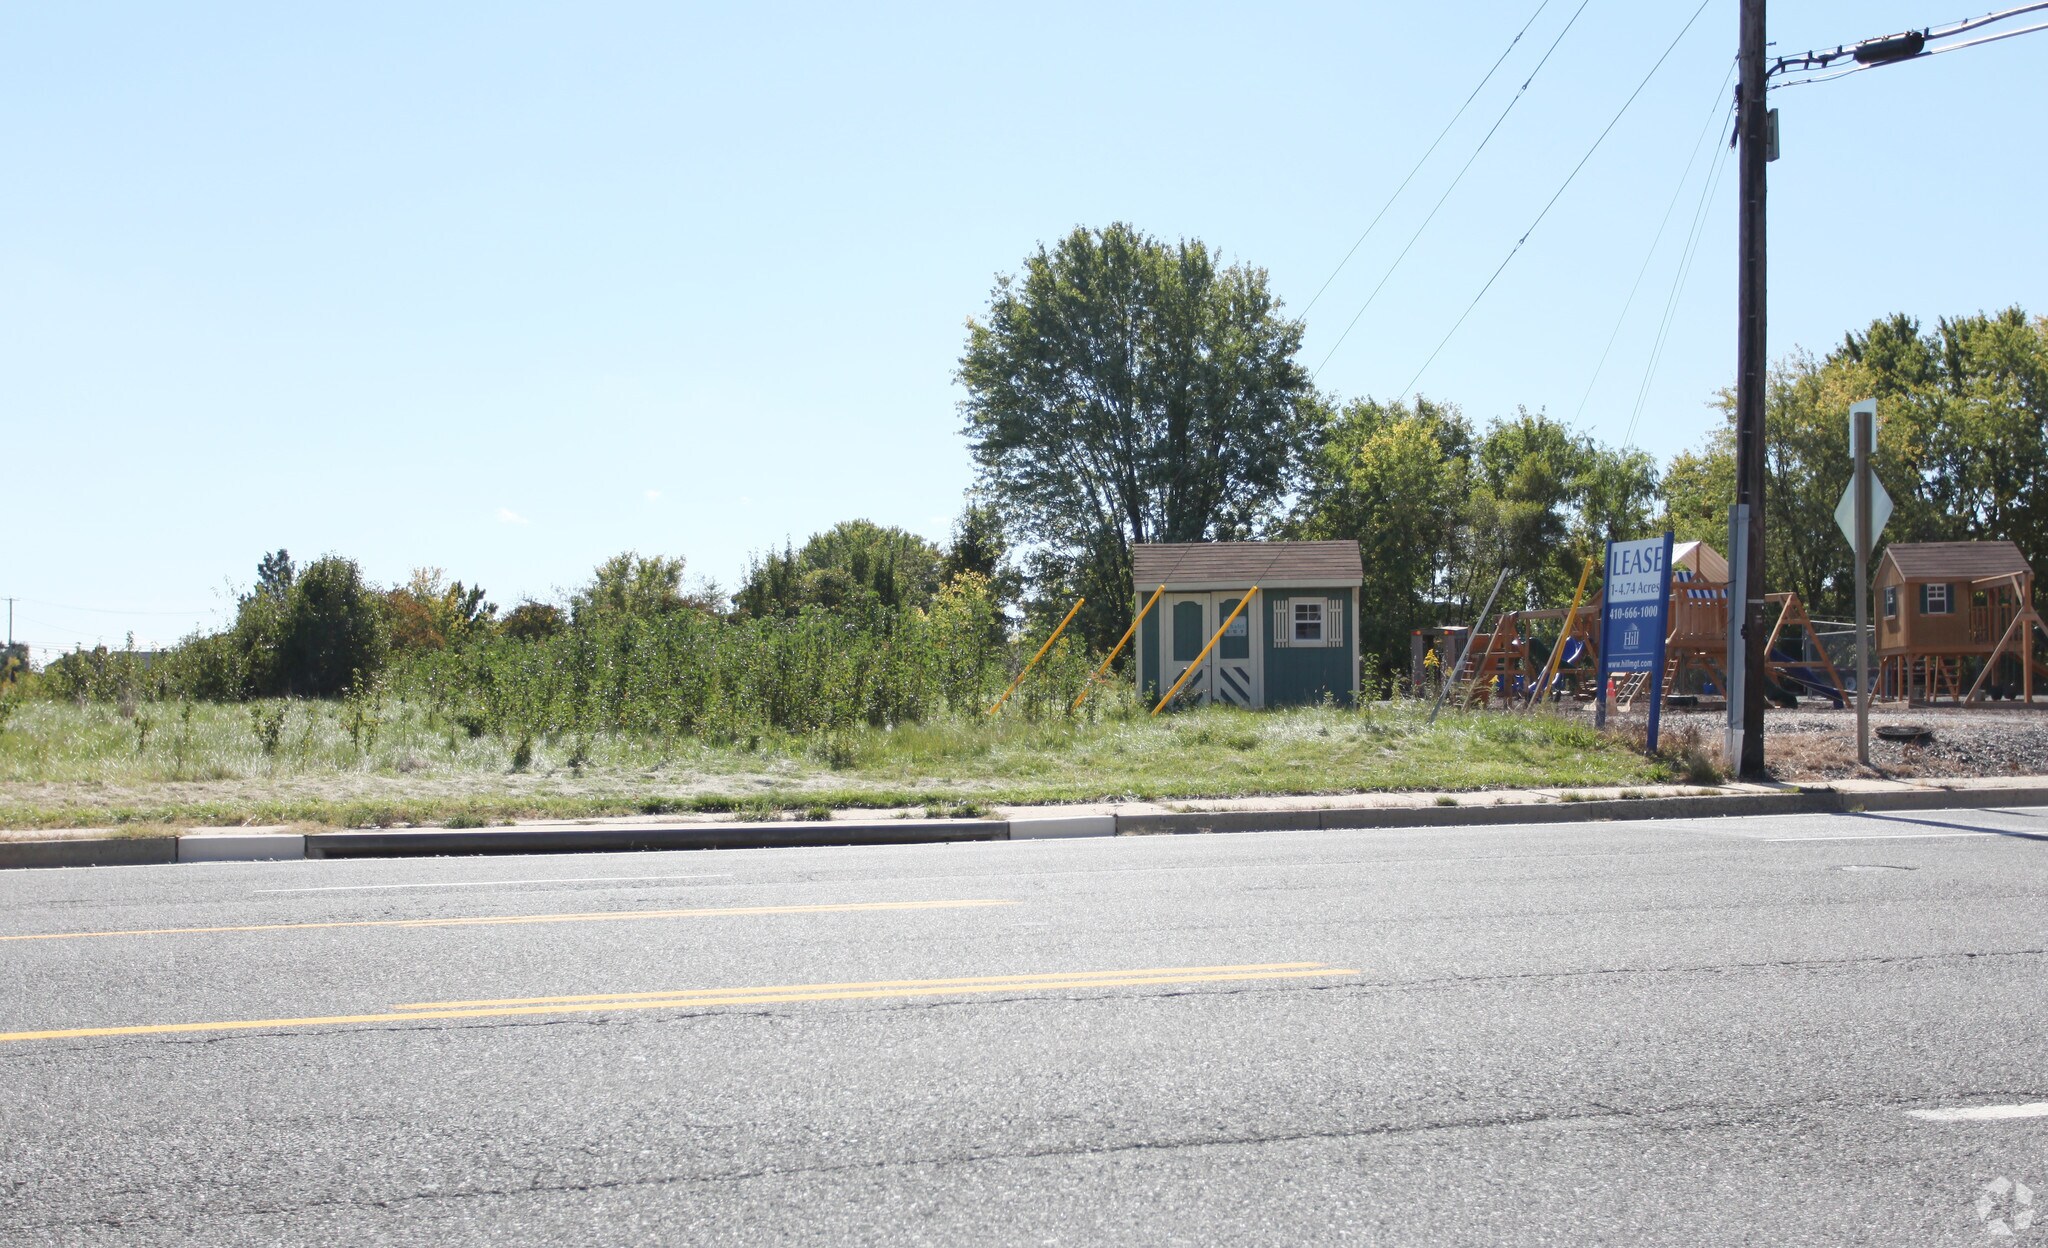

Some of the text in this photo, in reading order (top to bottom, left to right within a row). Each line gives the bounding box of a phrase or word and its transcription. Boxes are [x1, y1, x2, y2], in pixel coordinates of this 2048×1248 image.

[1612, 546, 1663, 576] LEASE
[1611, 581, 1660, 596] 1-4.74 Acres
[1609, 605, 1658, 620] 410-666-1000
[1623, 631, 1639, 646] Hill
[1607, 659, 1653, 669] www.hillmgt.com
